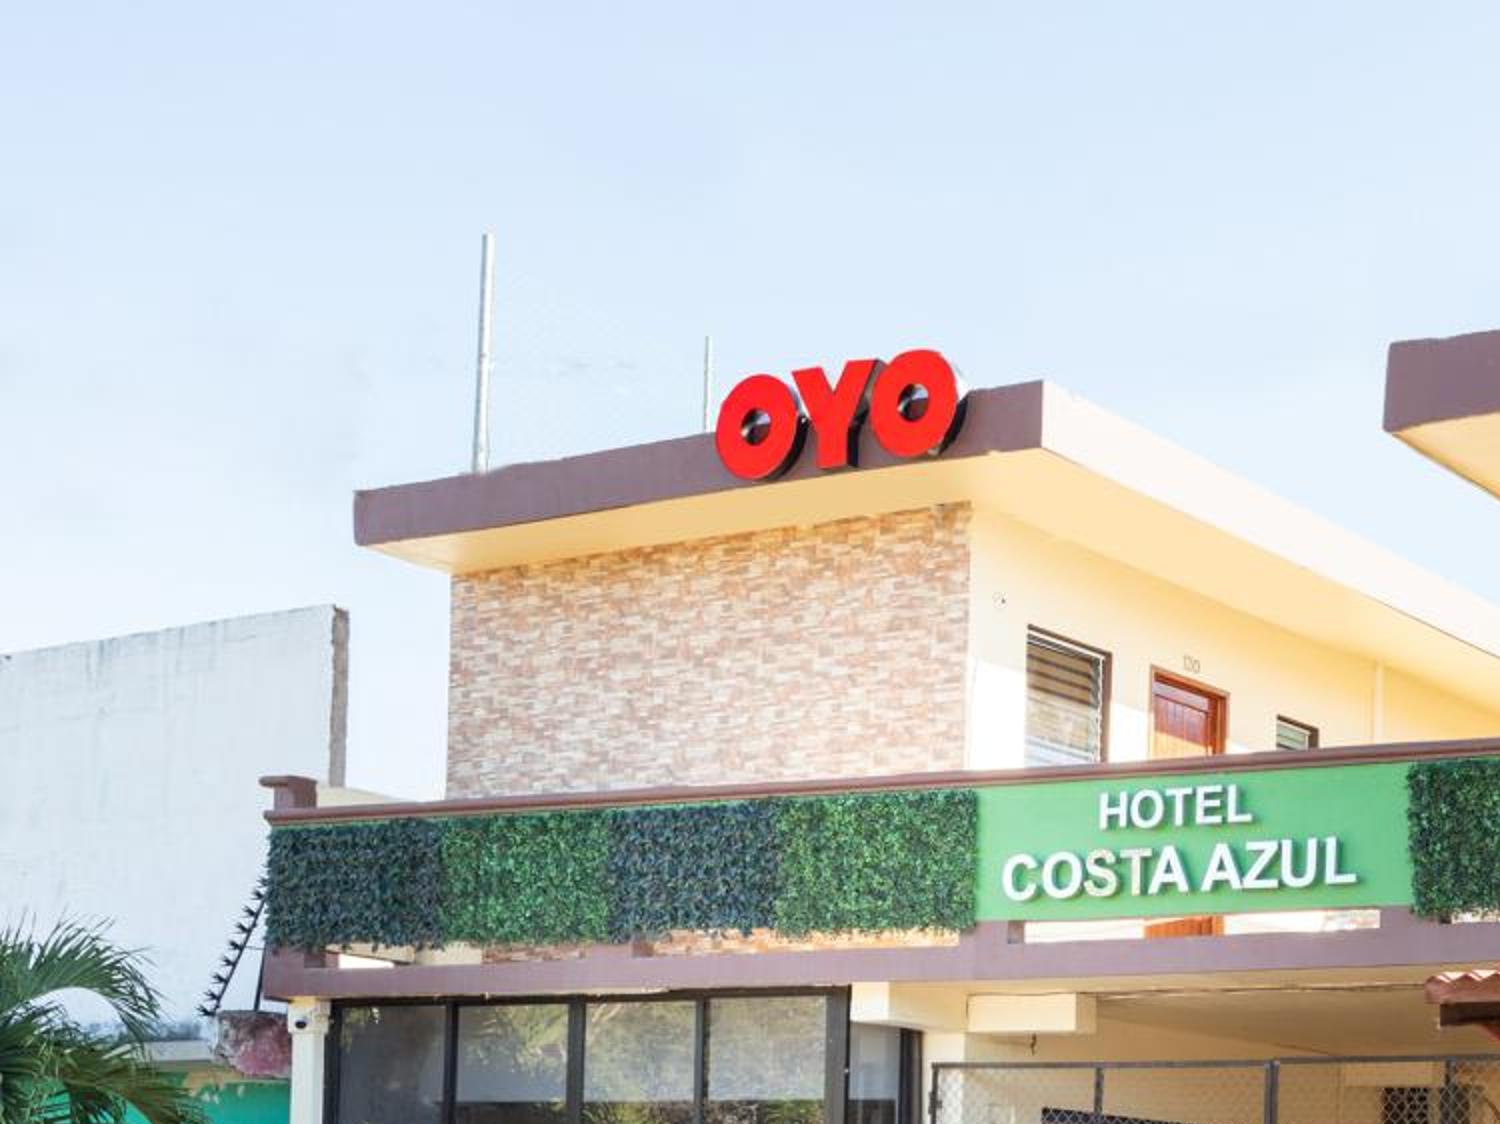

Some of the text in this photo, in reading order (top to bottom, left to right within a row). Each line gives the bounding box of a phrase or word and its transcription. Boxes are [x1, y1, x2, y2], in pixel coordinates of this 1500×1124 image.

[715, 349, 960, 480] OYO
[1099, 784, 1253, 830] HOTEL
[1001, 836, 1358, 902] COSTA AZUL
